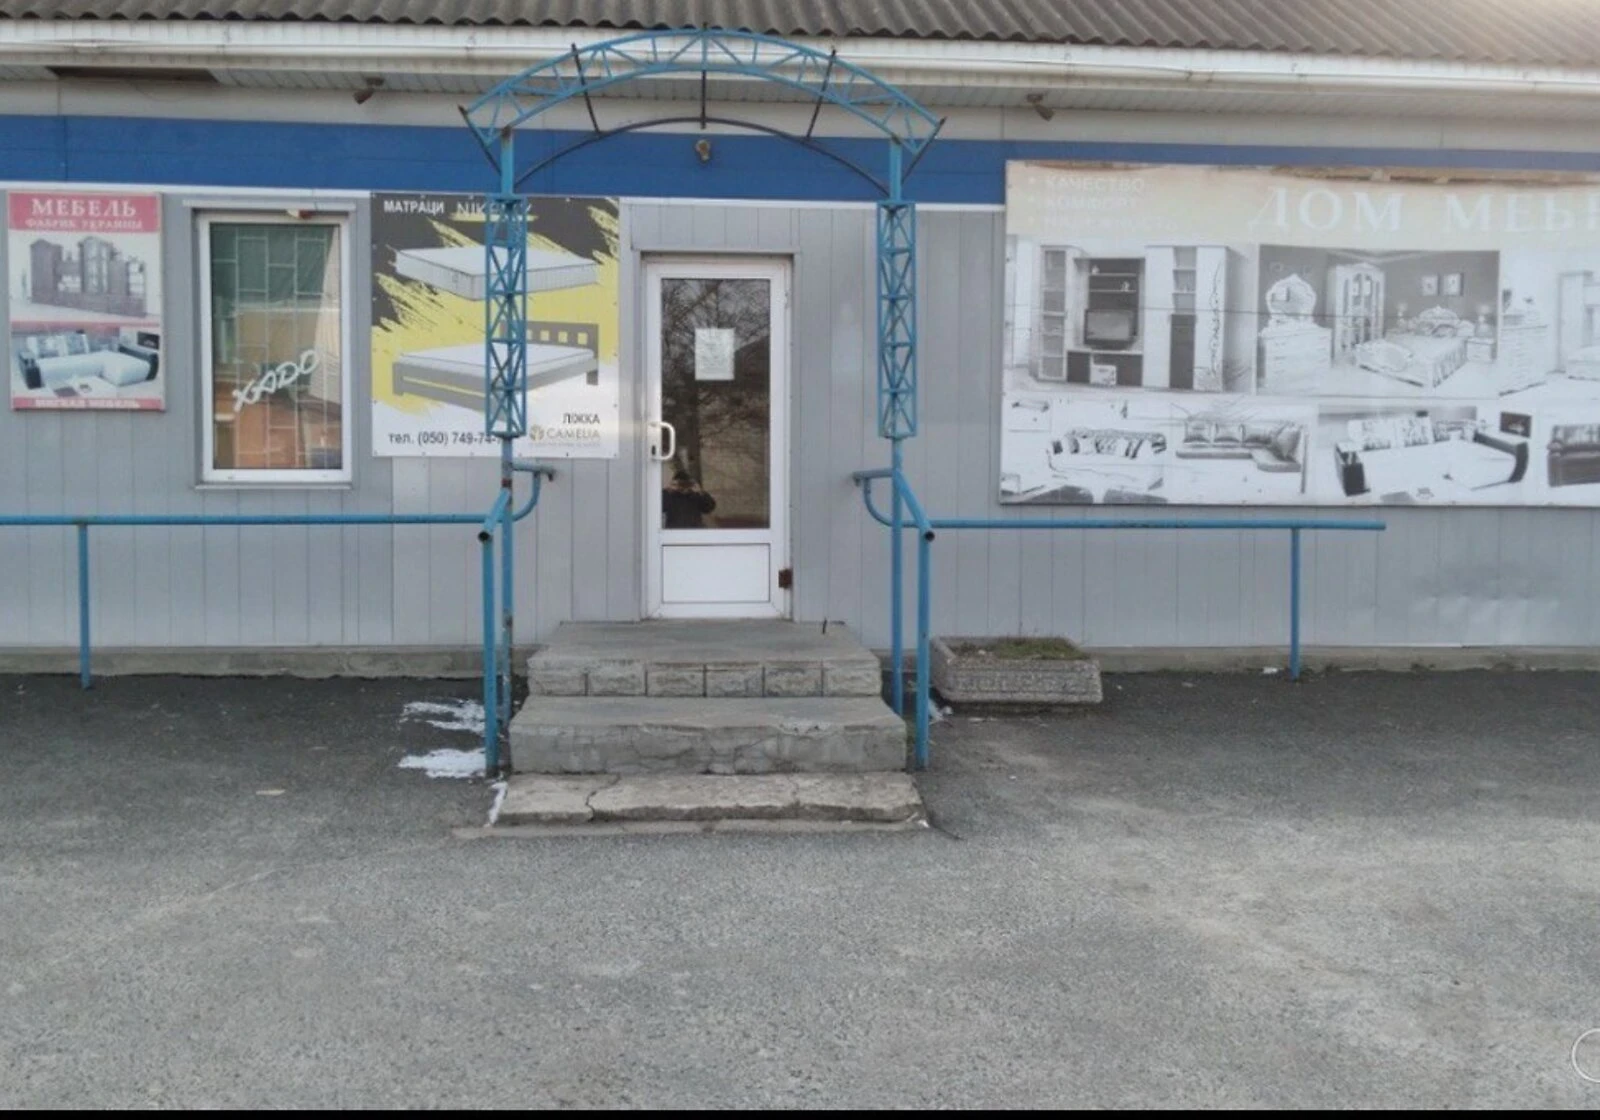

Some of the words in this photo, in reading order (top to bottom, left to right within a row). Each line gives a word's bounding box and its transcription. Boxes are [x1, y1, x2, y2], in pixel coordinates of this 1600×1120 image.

[31, 198, 137, 217] МЕБЕЛЬ
[383, 199, 445, 215] МАТРАЦИ
[1248, 186, 1405, 232] ДОМ
[388, 432, 414, 444] тел.
[418, 431, 449, 447] (050)
